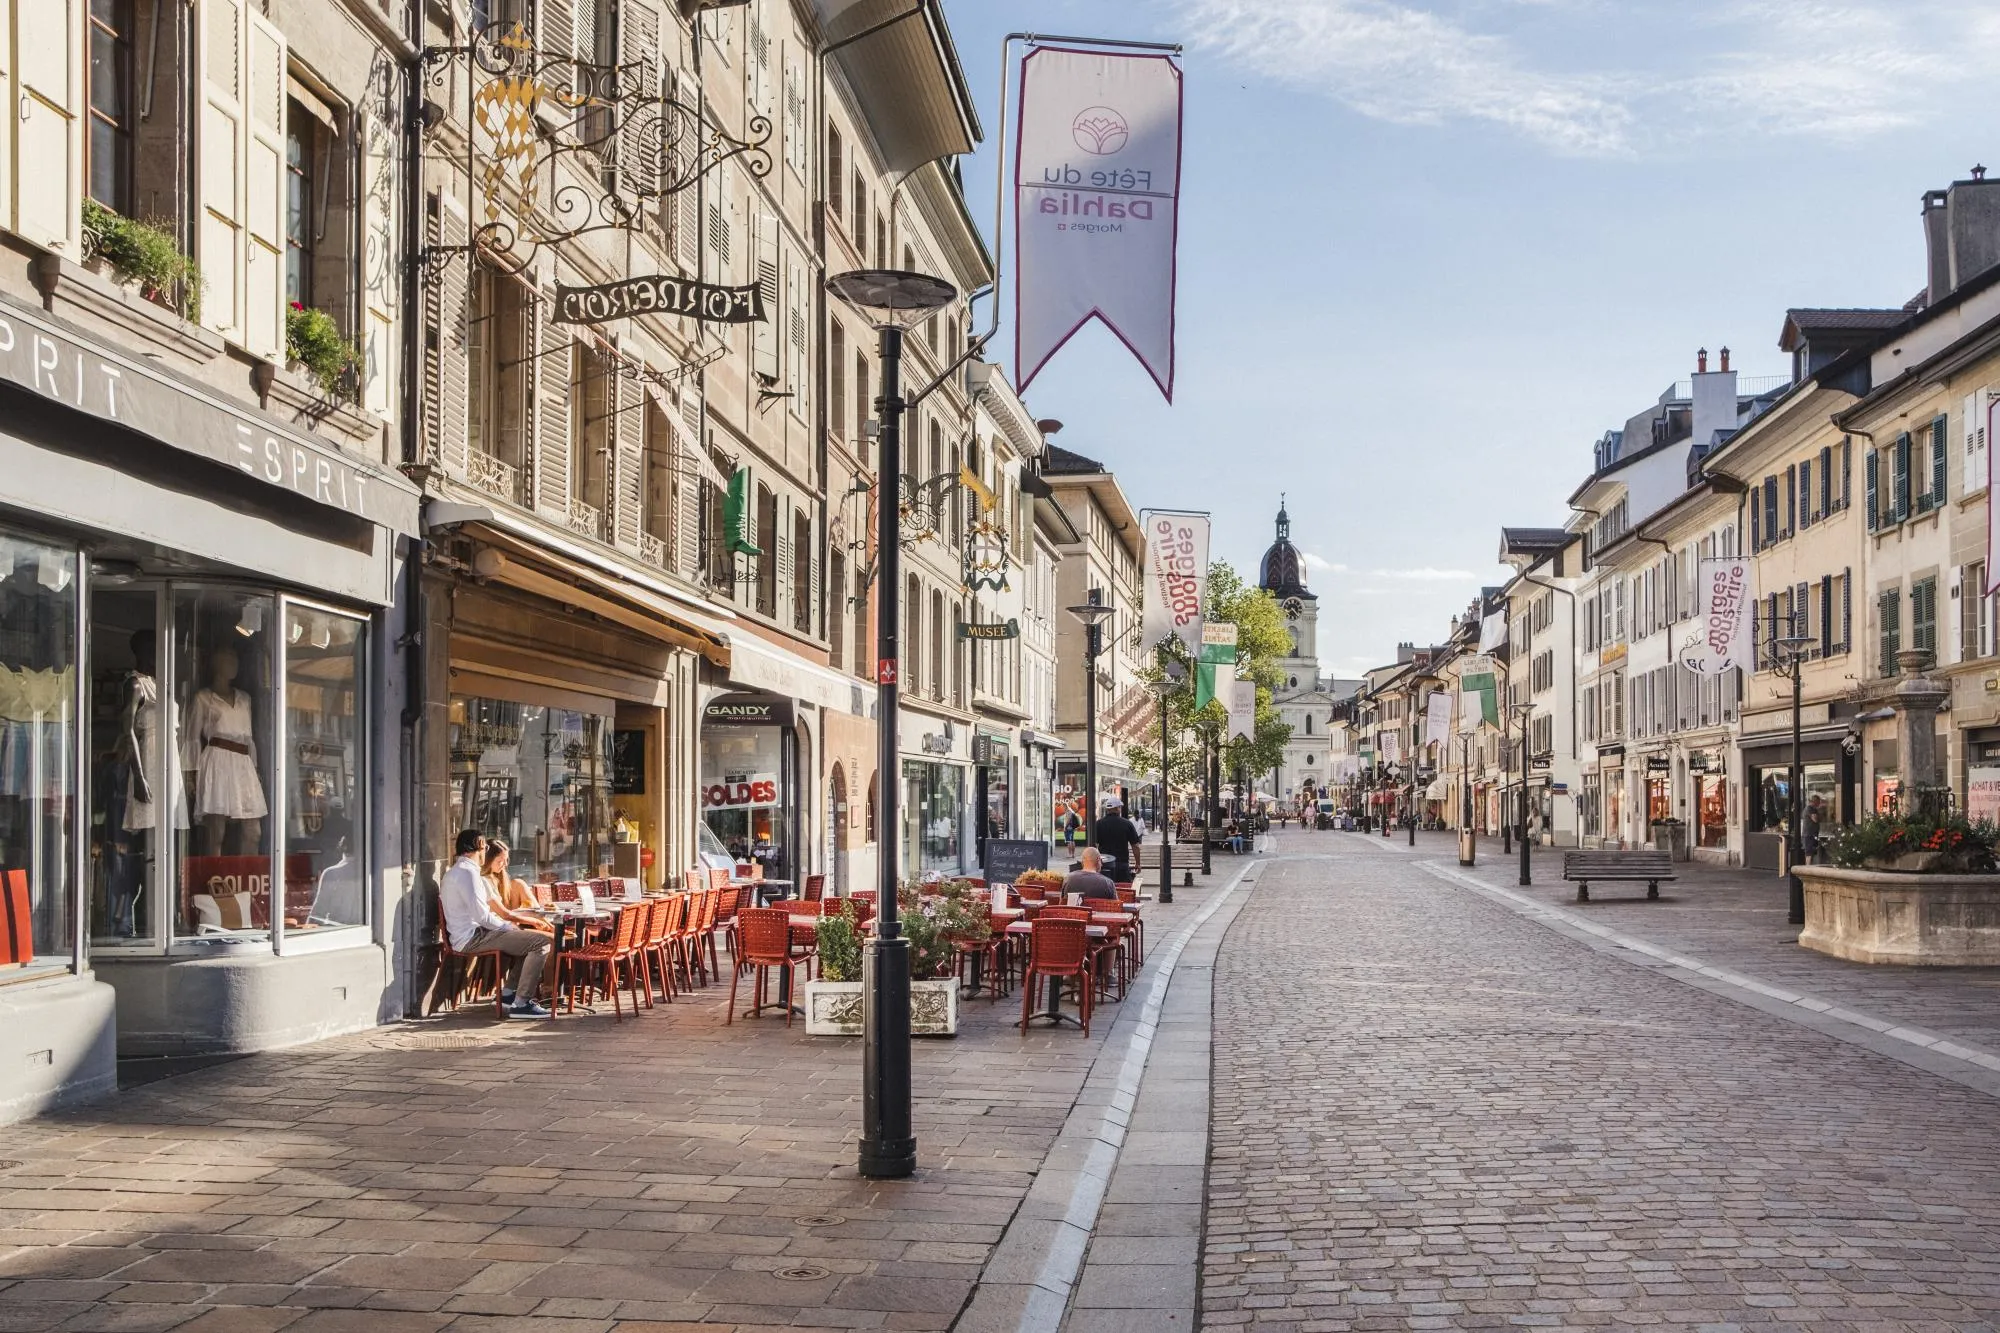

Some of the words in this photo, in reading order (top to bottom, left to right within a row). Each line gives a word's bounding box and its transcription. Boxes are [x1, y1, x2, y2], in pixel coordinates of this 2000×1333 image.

[237, 424, 366, 516] ESPRIT
[1708, 571, 1727, 649] morges
[1715, 565, 1744, 656] sous-rire
[706, 706, 770, 715] GANDY
[1108, 695, 1142, 726] MANOR
[1971, 781, 1988, 793] ACHAT
